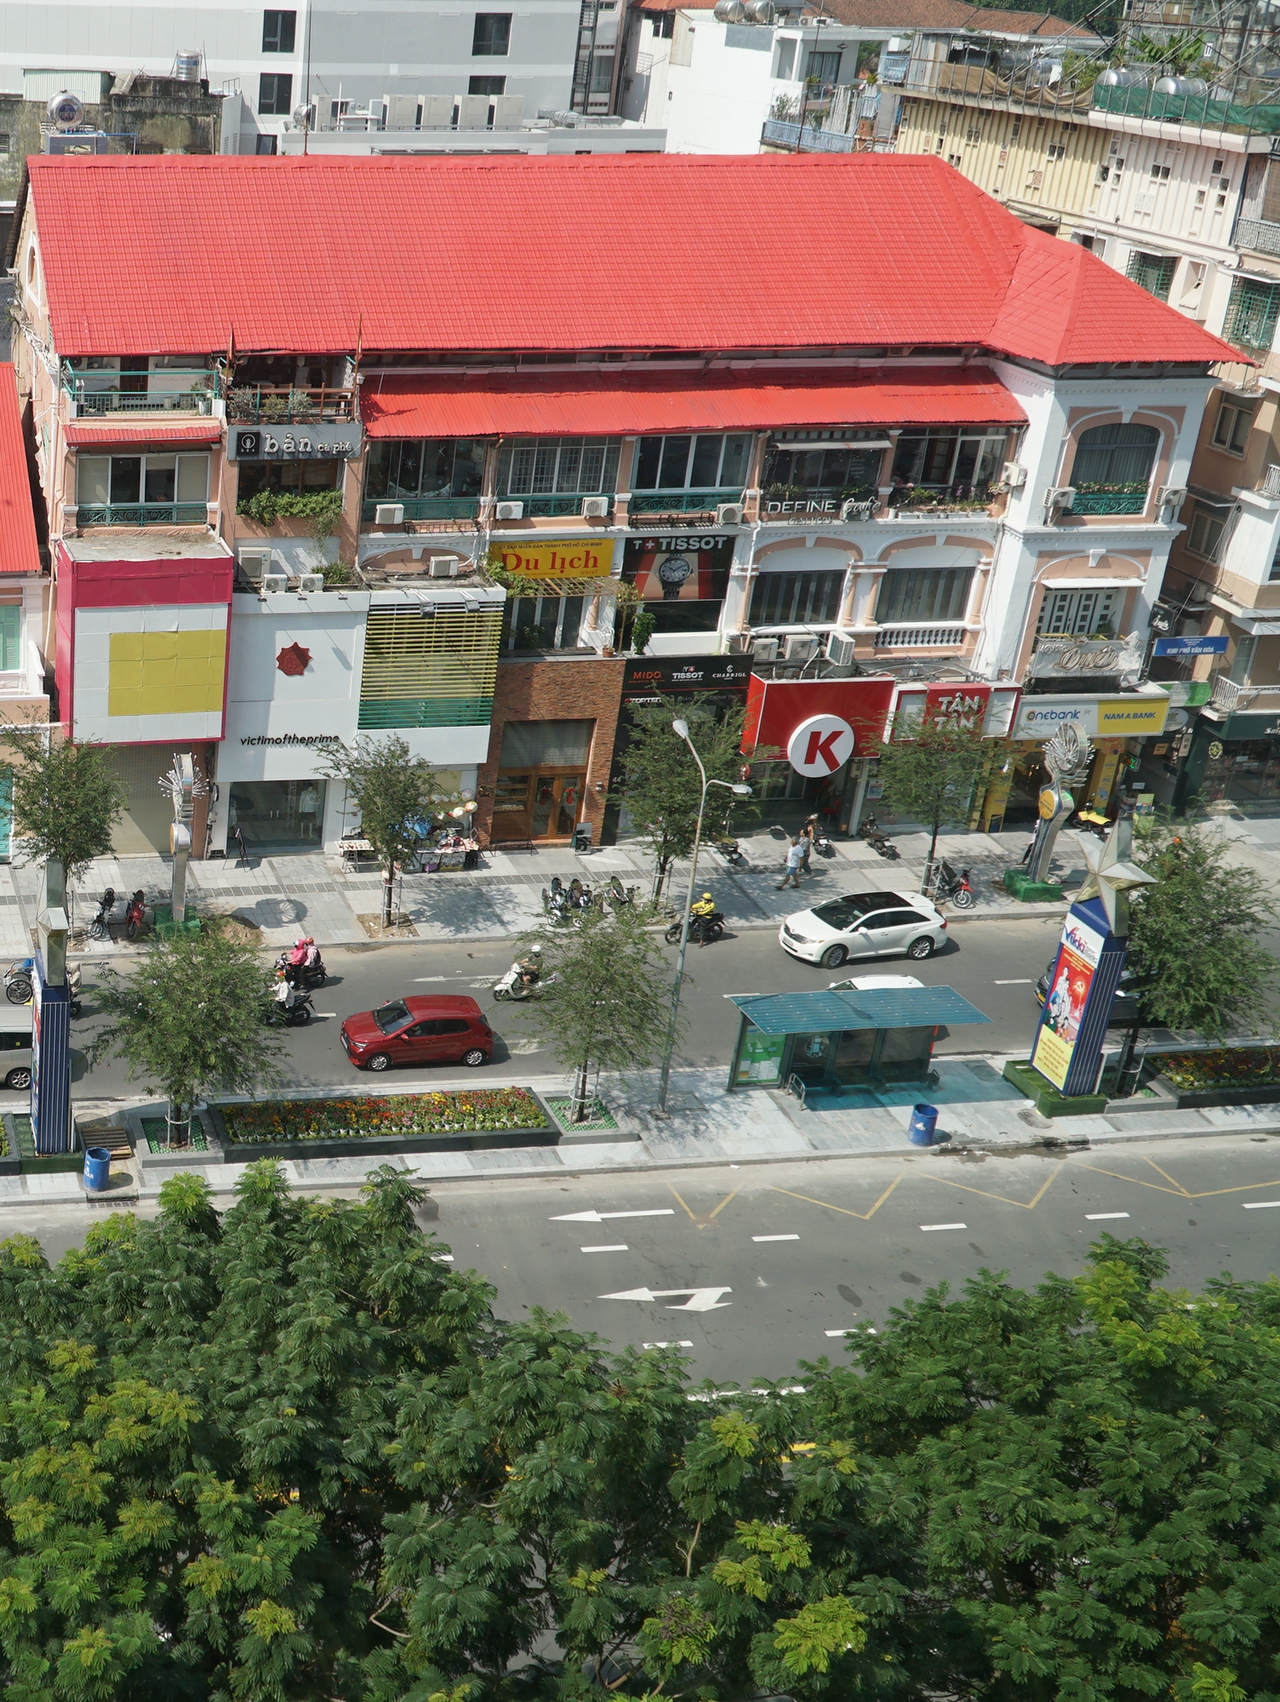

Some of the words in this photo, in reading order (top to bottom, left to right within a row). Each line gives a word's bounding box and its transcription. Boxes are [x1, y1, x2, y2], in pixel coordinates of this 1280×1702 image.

[767, 500, 837, 514] DEFINE
[659, 536, 727, 550] TISSOT
[500, 552, 540, 571] Du
[549, 550, 599, 574] lịch
[632, 671, 662, 679] MIDO
[938, 692, 980, 712] TÂN
[934, 713, 974, 731] TÂN
[1104, 713, 1123, 721] NAM
[1131, 711, 1157, 720] BANK
[240, 733, 340, 746] victimoftheprime
[804, 730, 845, 772] K
